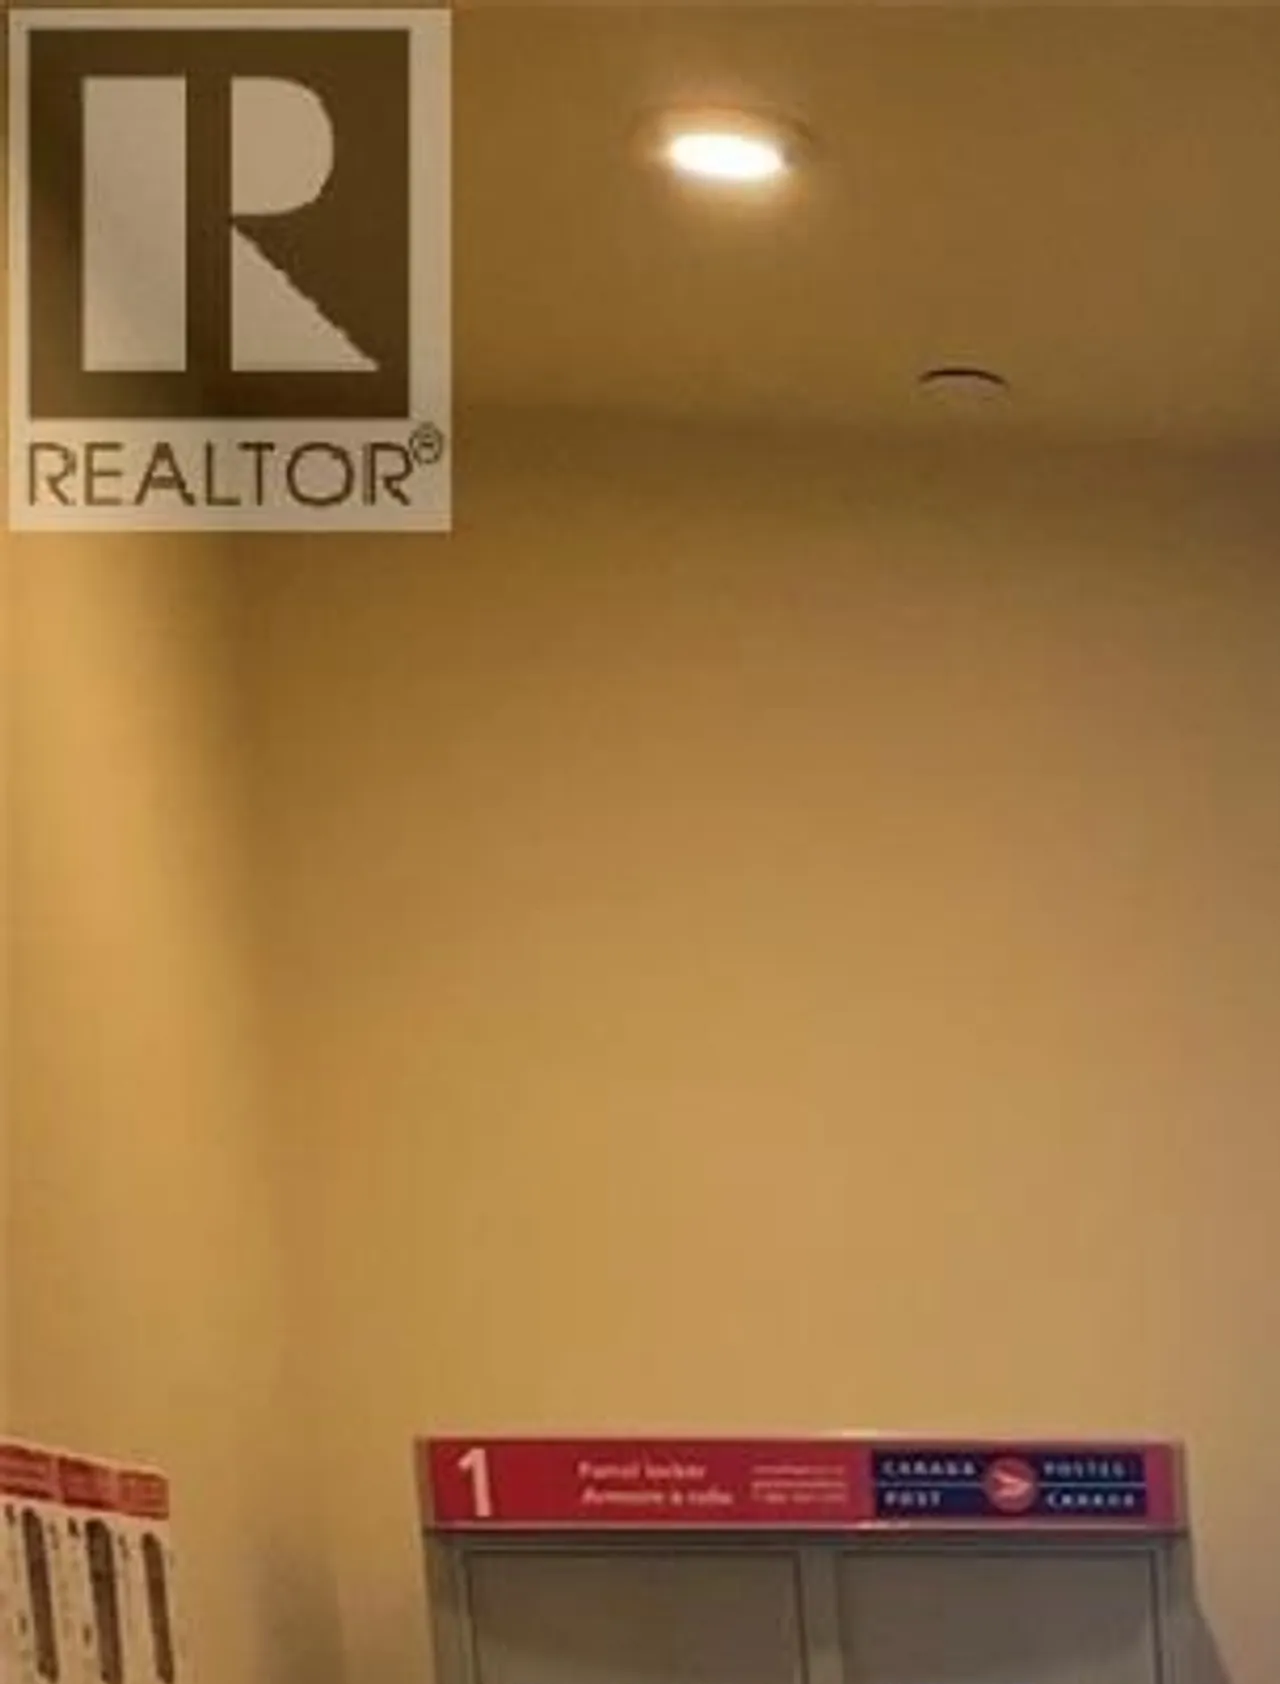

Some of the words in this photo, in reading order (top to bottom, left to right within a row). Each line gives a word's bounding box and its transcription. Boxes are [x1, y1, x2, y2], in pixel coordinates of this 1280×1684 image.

[882, 1461, 976, 1476] CANADA
[457, 1448, 492, 1518] 1
[884, 1490, 942, 1506] POST
